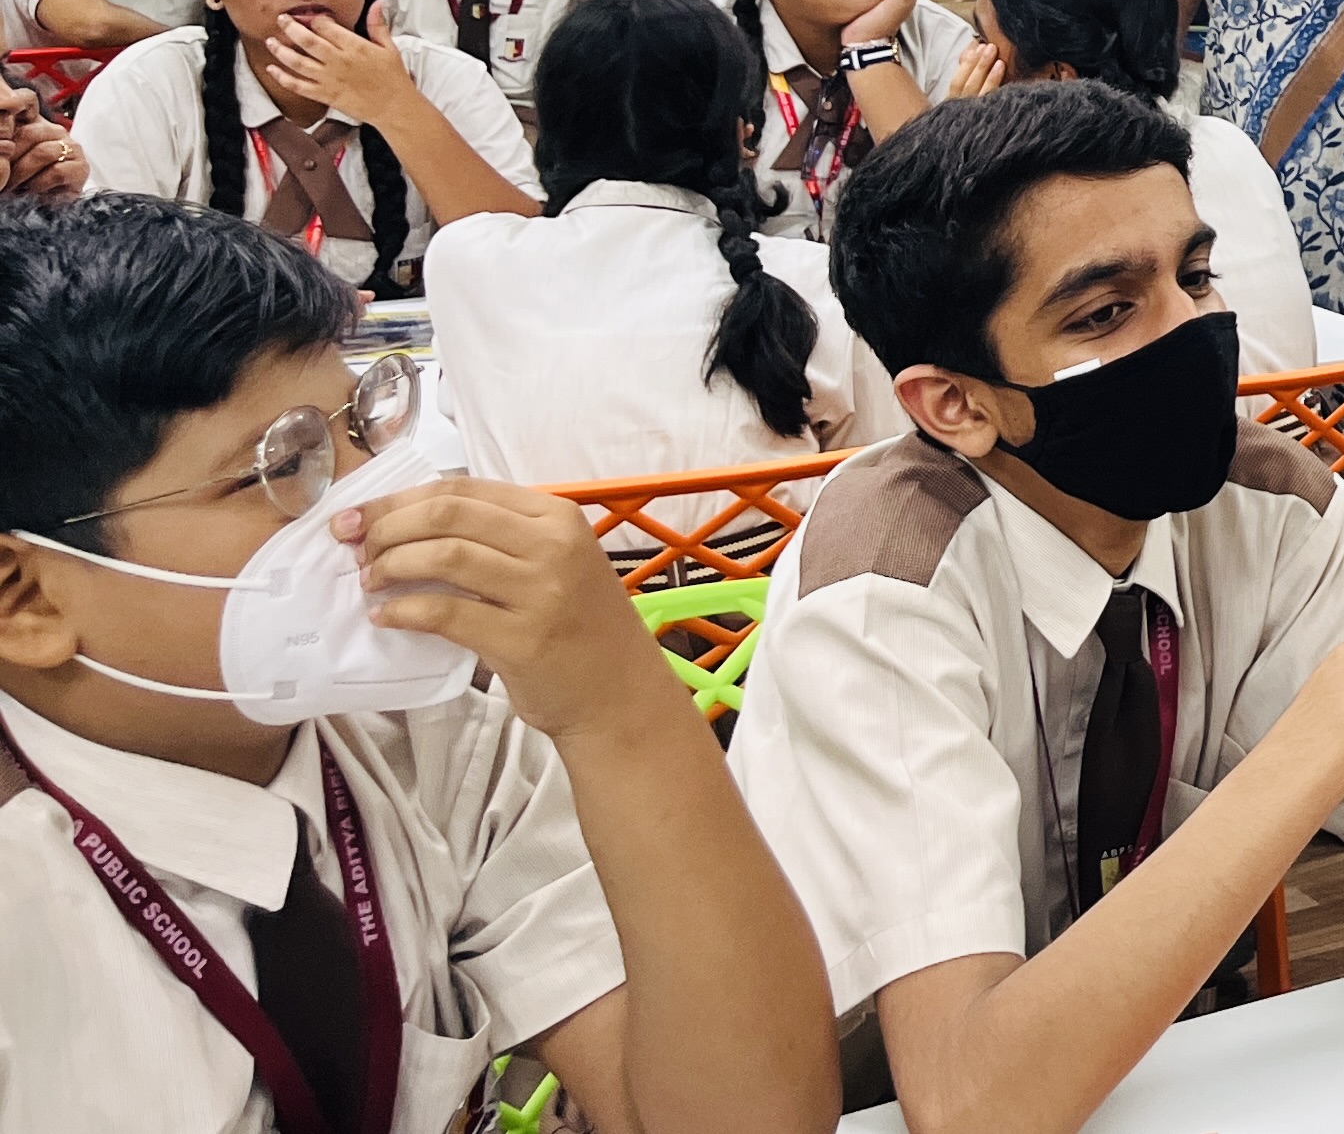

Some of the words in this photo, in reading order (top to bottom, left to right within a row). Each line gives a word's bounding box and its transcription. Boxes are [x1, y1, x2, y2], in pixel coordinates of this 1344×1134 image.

[1156, 603, 1172, 675] SCHOOL
[340, 817, 369, 894] ADITYA
[80, 833, 147, 904] PUBLIC
[142, 902, 207, 979] SCHOOL
[362, 900, 379, 947] THE
